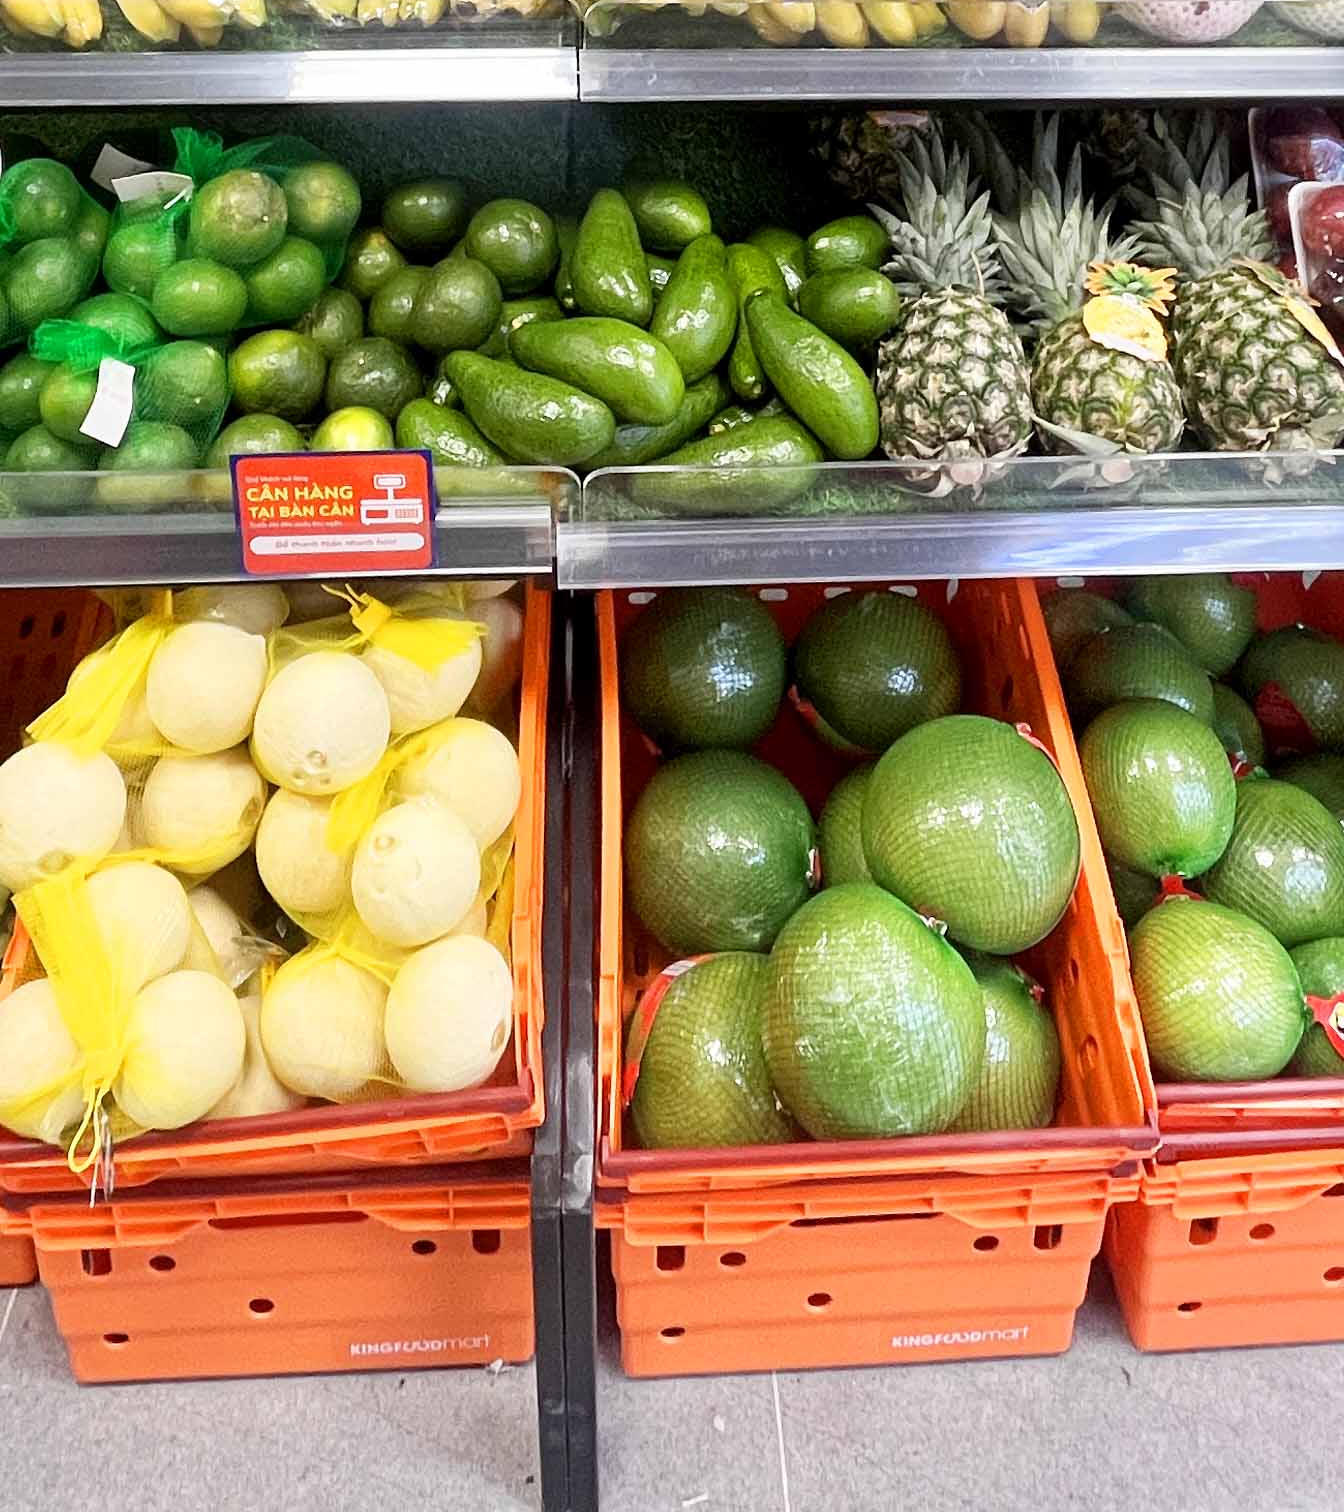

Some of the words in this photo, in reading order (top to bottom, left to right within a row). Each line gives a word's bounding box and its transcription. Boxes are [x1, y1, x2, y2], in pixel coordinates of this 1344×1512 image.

[246, 483, 289, 502] CÂN
[294, 482, 353, 500] HÀNG
[279, 503, 315, 518] BÀN
[319, 501, 355, 517] CÂN
